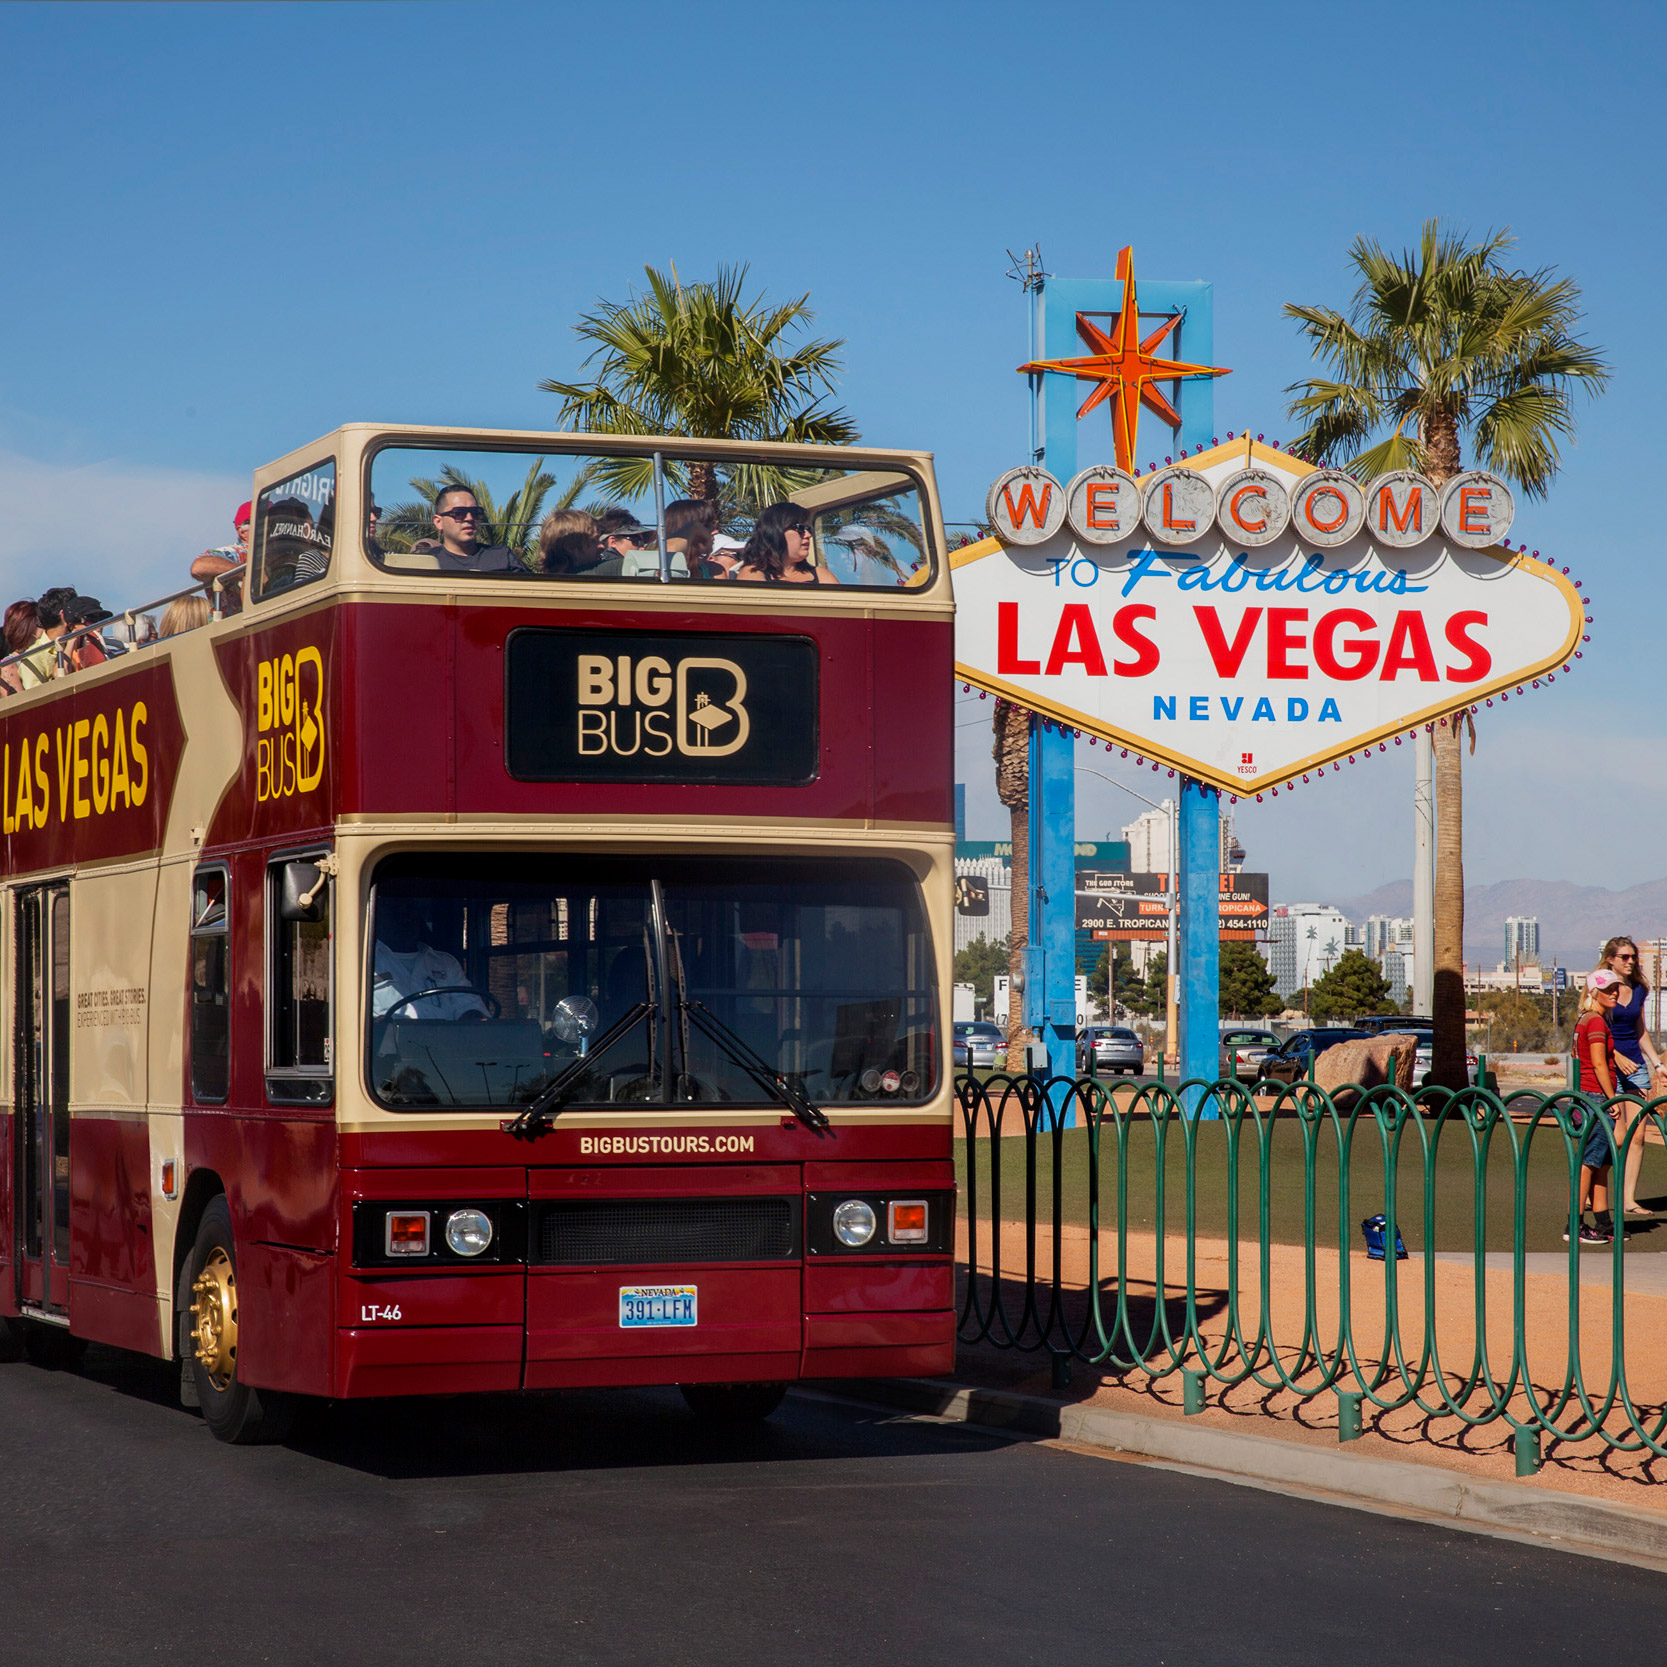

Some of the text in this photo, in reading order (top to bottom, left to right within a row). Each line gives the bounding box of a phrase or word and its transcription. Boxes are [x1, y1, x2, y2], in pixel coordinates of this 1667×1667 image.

[1001, 482, 1492, 534] WELCOME
[1046, 549, 1430, 598] TO Fabulous
[997, 602, 1493, 683] LAS VEGAS
[258, 653, 295, 732] BIG
[578, 655, 673, 707] BIG
[1153, 695, 1342, 722] NEVADA
[578, 710, 673, 757] BUS
[3, 701, 149, 835] LAS VEGAS
[258, 732, 296, 802] BUS
[1237, 766, 1257, 774] YESCO
[1218, 904, 1261, 912] ROPICANA
[1231, 893, 1251, 901] GUN!
[1082, 919, 1104, 928] 2900
[1106, 919, 1116, 928] E.
[1118, 919, 1169, 928] TROPICAN
[1226, 920, 1267, 928] 454-1110
[580, 1135, 754, 1154] BIGBUSTOURS.COM
[641, 1288, 677, 1297] NEVADA
[361, 1304, 402, 1321] LT-46
